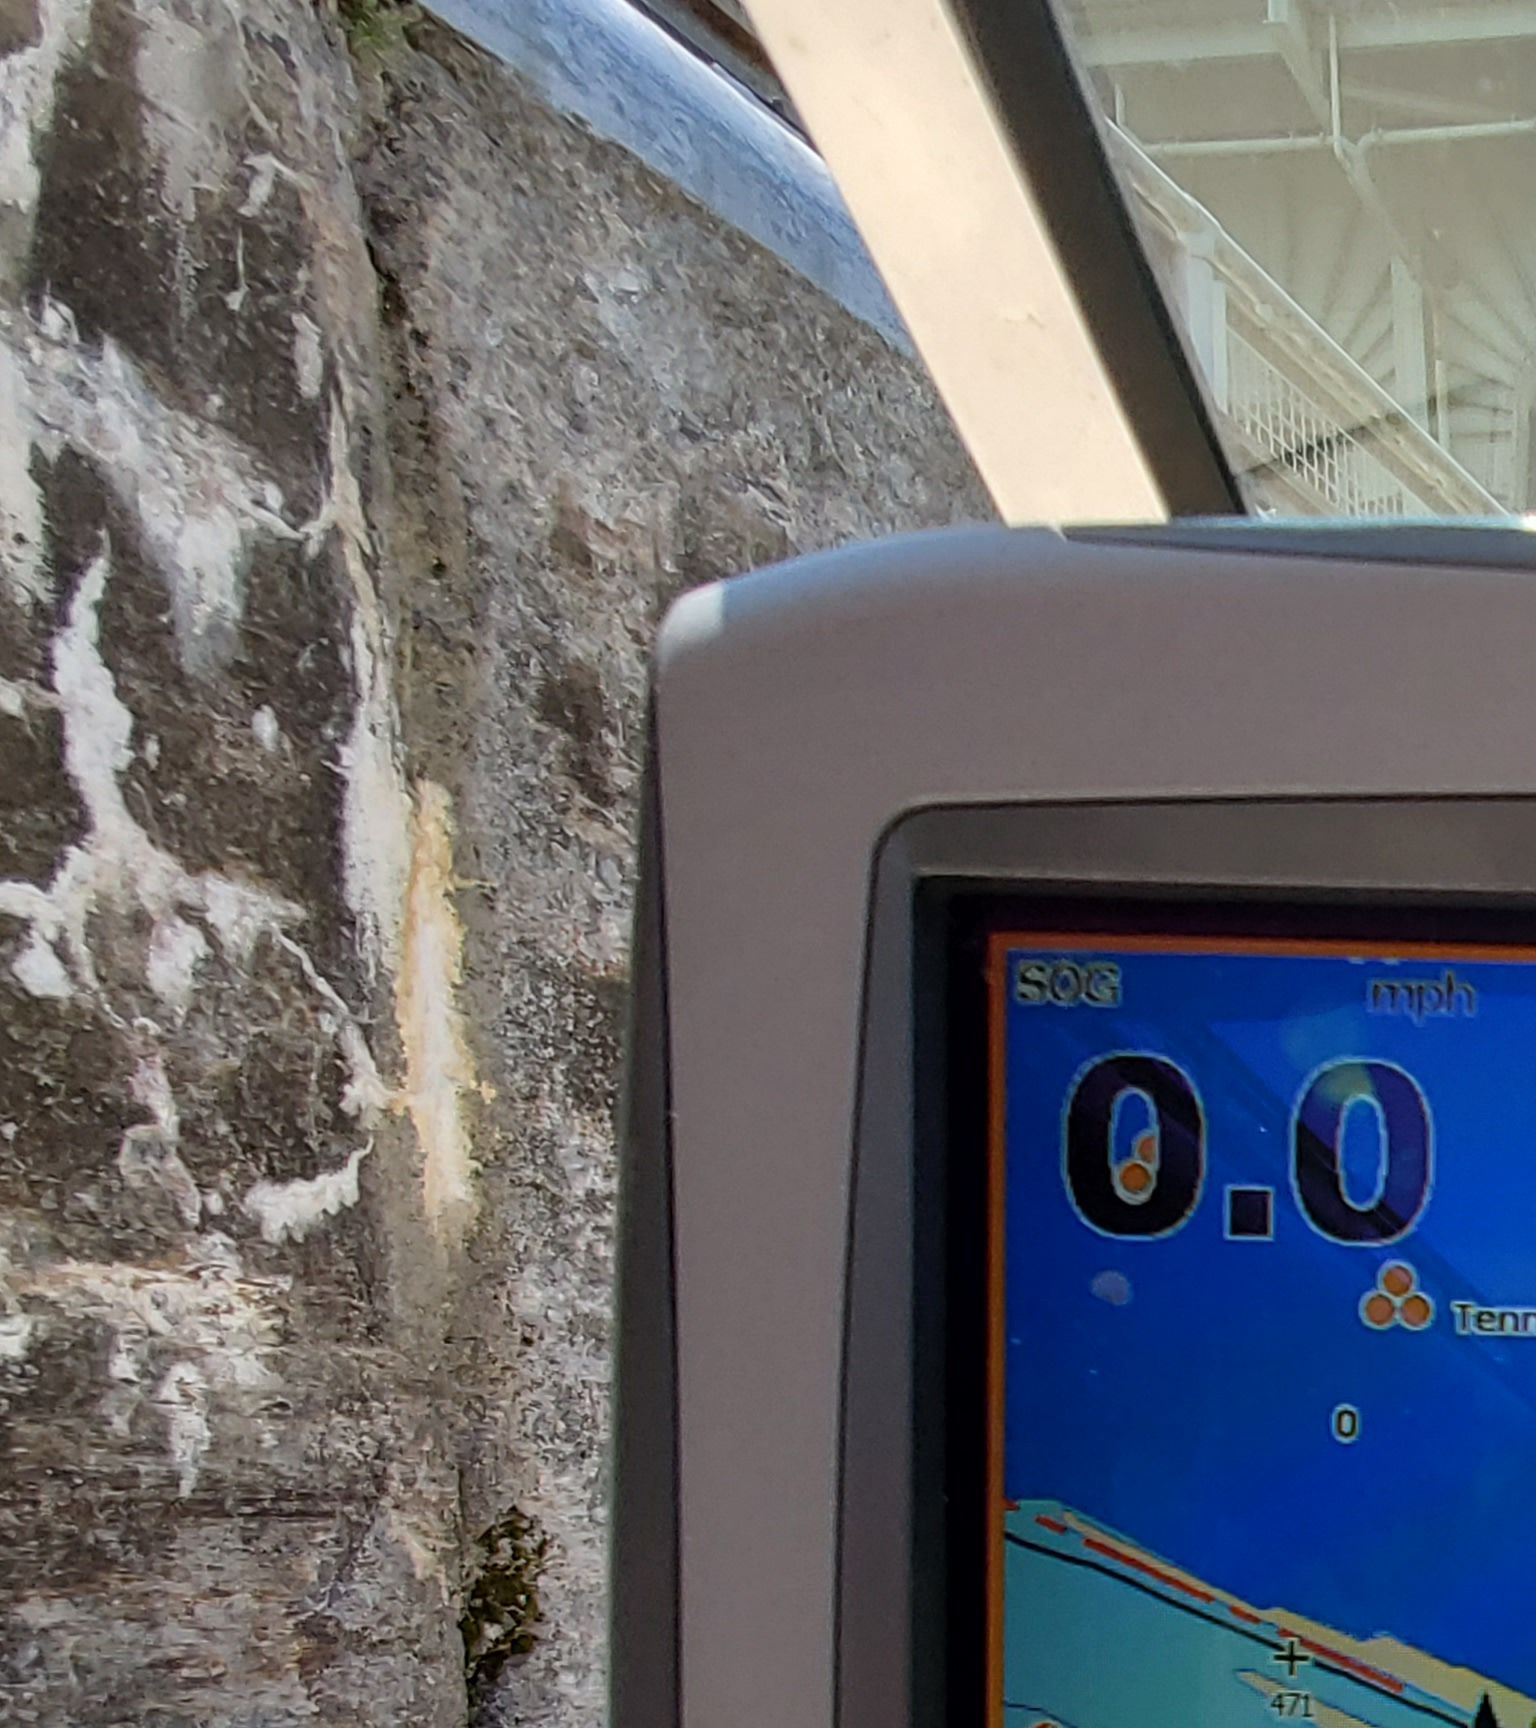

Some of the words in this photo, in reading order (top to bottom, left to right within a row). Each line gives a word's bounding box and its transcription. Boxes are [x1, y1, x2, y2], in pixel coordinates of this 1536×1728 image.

[1016, 960, 1122, 1005] SOG
[1368, 973, 1476, 1023] mph
[1061, 1050, 1434, 1246] 0.0
[1270, 1693, 1315, 1718] 471
